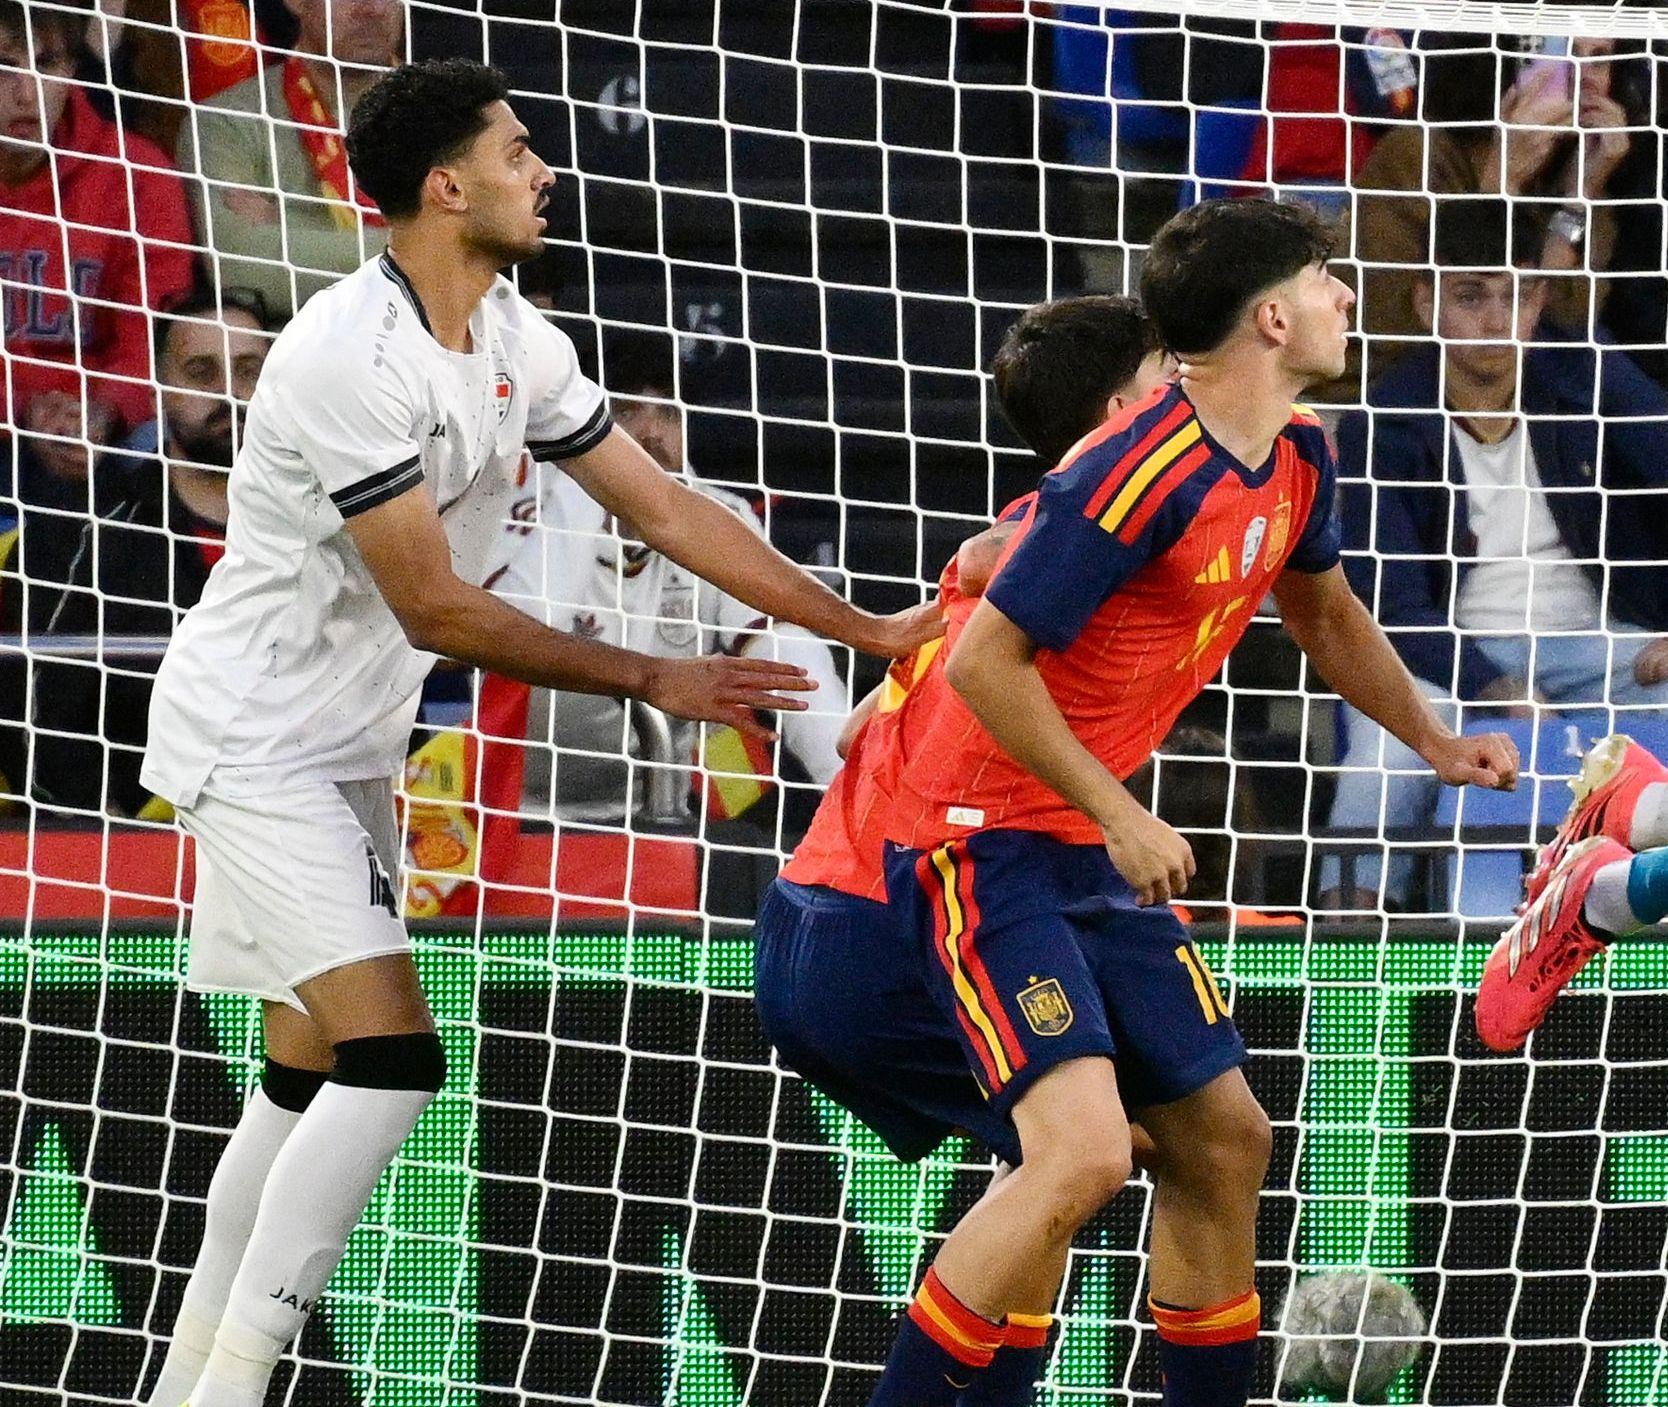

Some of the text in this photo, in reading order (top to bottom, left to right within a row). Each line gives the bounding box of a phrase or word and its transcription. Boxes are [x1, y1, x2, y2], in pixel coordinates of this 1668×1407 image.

[599, 75, 645, 134] 6
[1174, 941, 1232, 1026] 1
[268, 1286, 314, 1314] JAK
